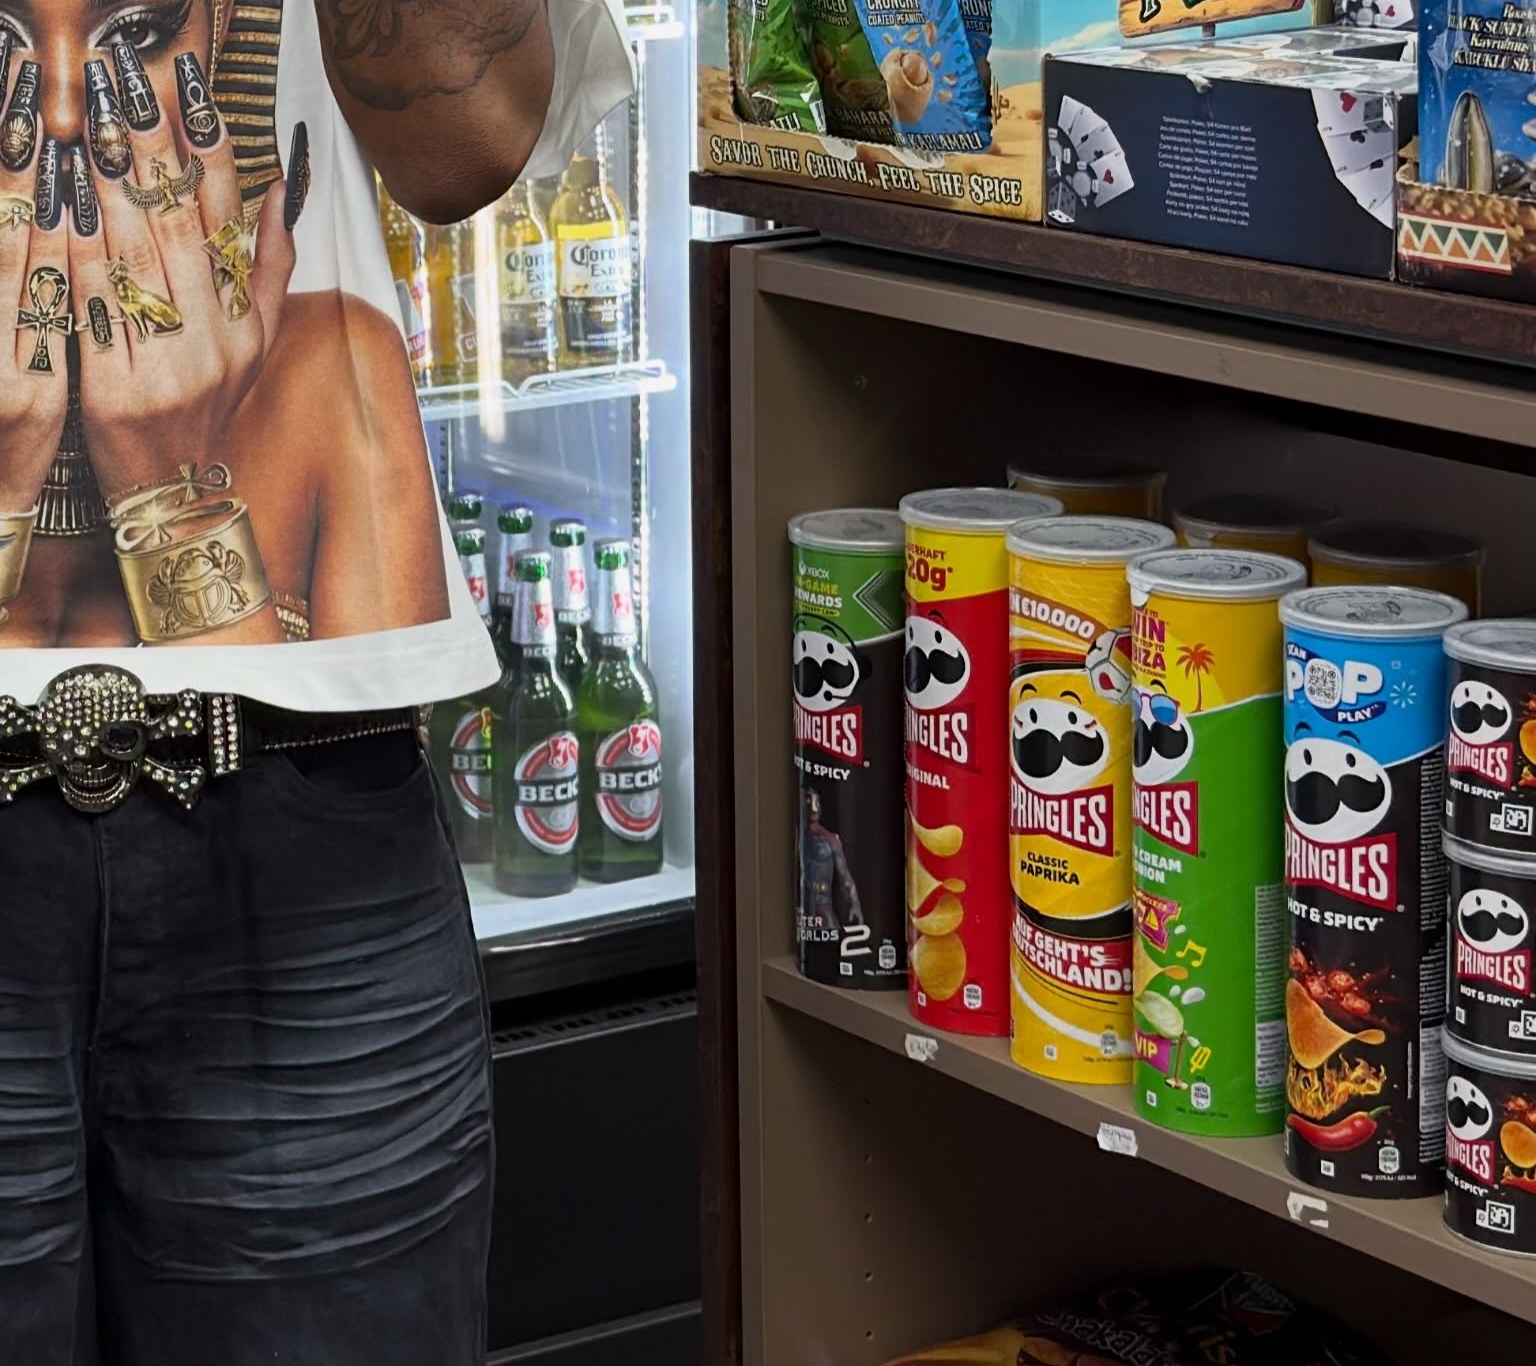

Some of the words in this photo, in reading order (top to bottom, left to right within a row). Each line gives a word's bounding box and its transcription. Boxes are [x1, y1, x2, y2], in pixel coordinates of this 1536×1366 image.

[868, 14, 895, 27] COATED
[896, 11, 925, 25] PEANUTS
[710, 135, 762, 166] SAVOR
[767, 147, 801, 172] THE
[806, 150, 874, 188] CRUNCH,
[878, 162, 920, 191] FEEL
[924, 171, 964, 197] THE
[969, 176, 1022, 205] SPICE
[805, 566, 830, 580] XBOX
[1022, 597, 1095, 639] €10.000
[1287, 644, 1307, 660] SCAN
[794, 712, 857, 758] RINGLES
[906, 712, 968, 764] INGLES
[814, 763, 851, 781] SPICY
[1448, 732, 1508, 783] PRINGLES
[1449, 777, 1463, 791] HOT
[1472, 784, 1502, 800] SPICY
[1011, 781, 1106, 848] PRINGLES
[1132, 787, 1191, 846] NGLES
[1021, 861, 1080, 885] PAPRIKA
[1028, 852, 1068, 869] CLASSIC
[1140, 850, 1182, 874] CREAM
[1285, 821, 1388, 902] PRINGLES
[1287, 897, 1309, 919] HOT
[1310, 906, 1320, 922] &
[1323, 911, 1381, 932] SPICY
[840, 925, 872, 957] 2
[1016, 913, 1032, 938] AUF
[1034, 930, 1105, 965] GEHT'S
[1015, 930, 1131, 992] UTSCHLAND!
[1457, 938, 1526, 990] PRINGLES
[1460, 985, 1477, 998] HOT
[1478, 990, 1485, 1001] &
[1486, 992, 1520, 1007] SPICY
[1135, 1035, 1158, 1058] VIP
